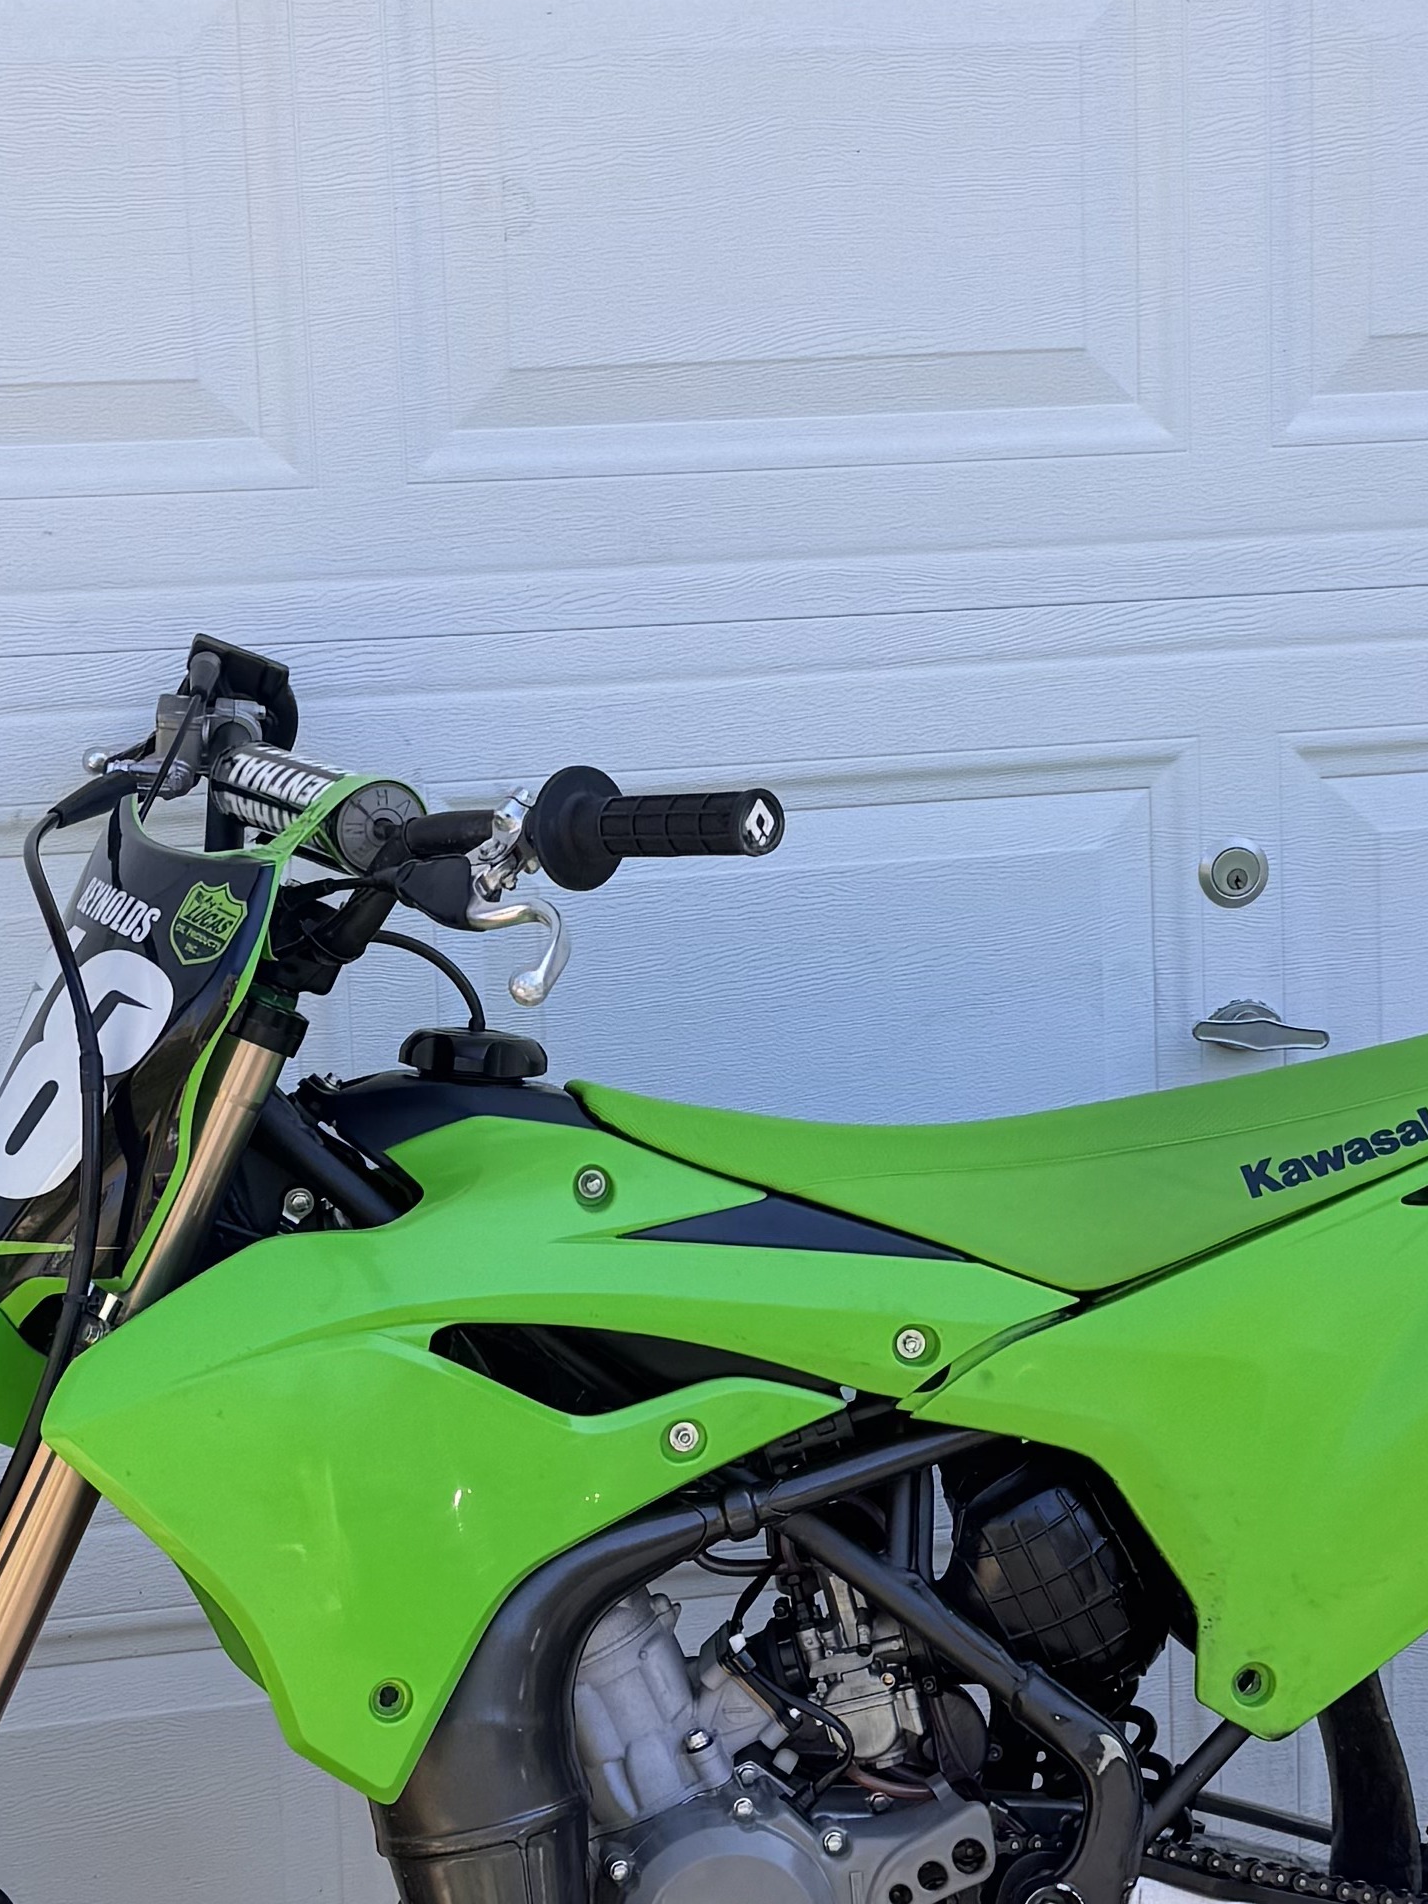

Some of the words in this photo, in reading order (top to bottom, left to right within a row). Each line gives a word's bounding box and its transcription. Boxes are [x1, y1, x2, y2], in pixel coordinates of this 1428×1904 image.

[228, 753, 335, 808] ENTHAL
[77, 877, 162, 943] REYNOLDS
[183, 905, 234, 935] LUCAS
